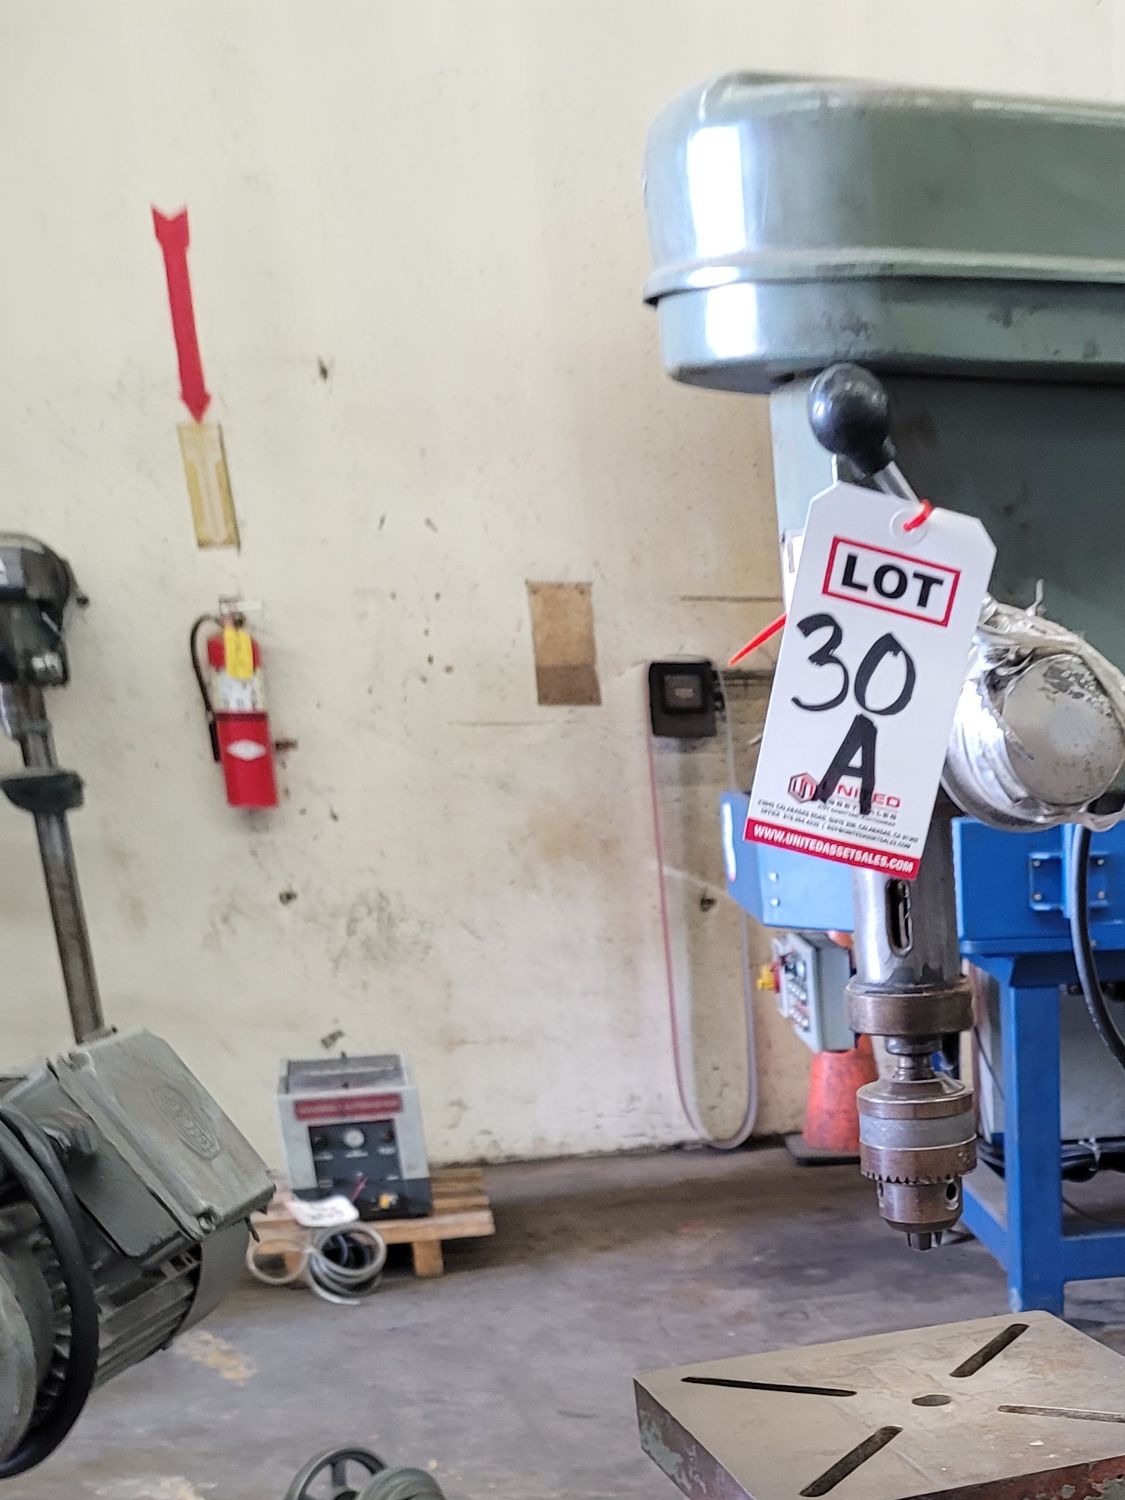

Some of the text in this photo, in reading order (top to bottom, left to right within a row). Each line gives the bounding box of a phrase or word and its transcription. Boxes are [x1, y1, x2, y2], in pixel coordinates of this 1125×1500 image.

[841, 553, 944, 609] LOT
[791, 613, 917, 716] 30
[812, 713, 878, 816] A
[753, 823, 914, 874] WWW.UNITEDASSETSALES.COM
